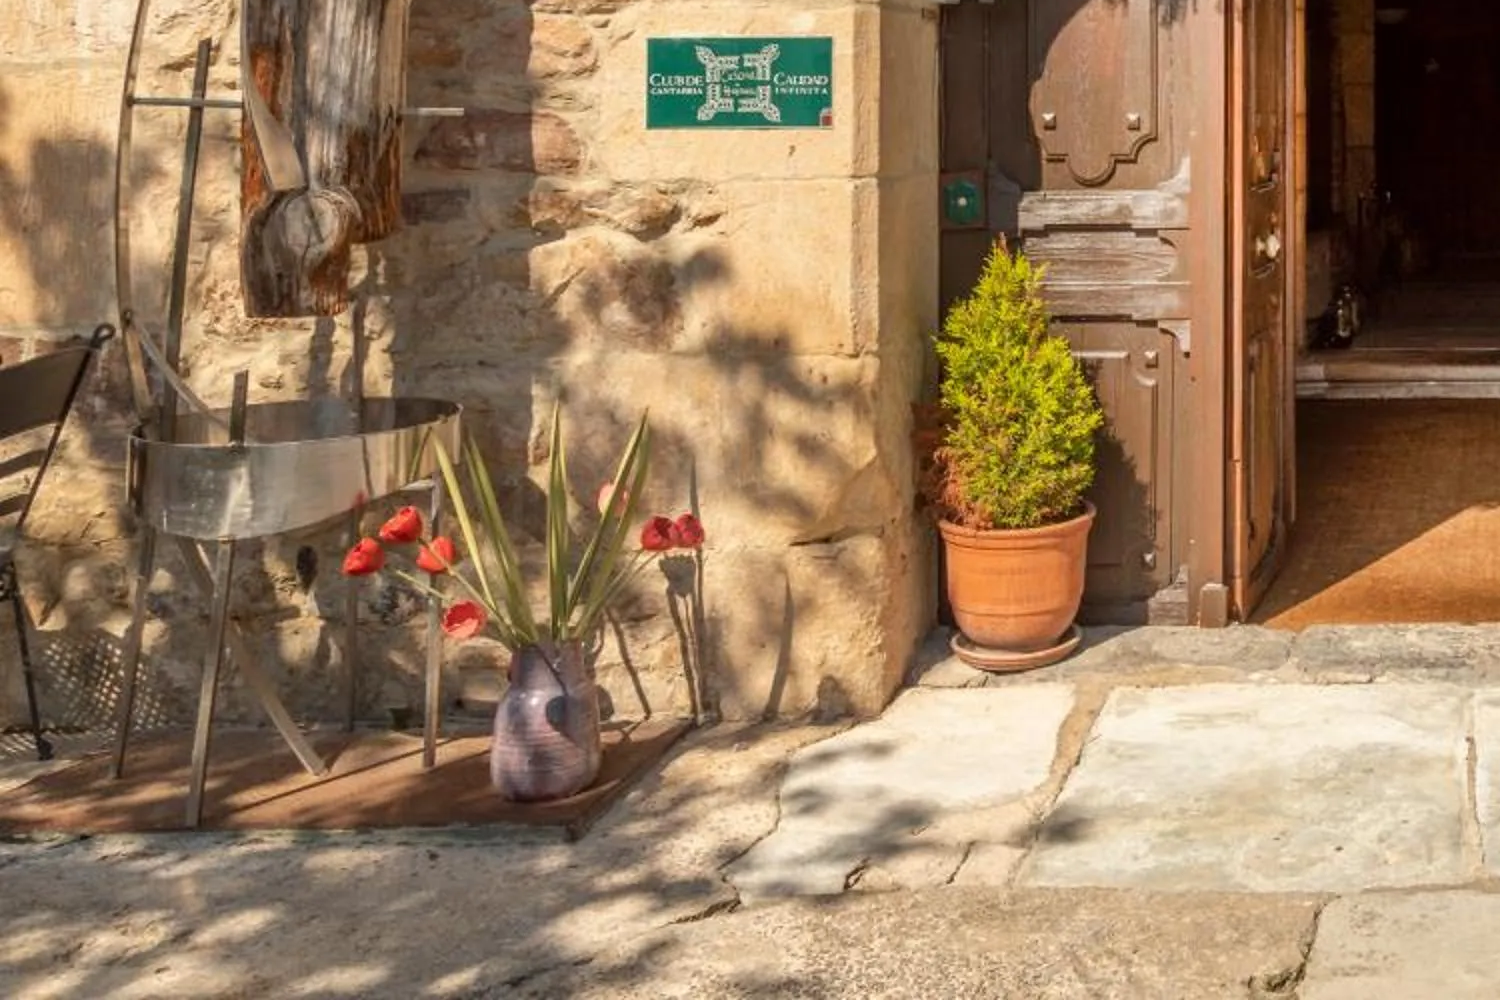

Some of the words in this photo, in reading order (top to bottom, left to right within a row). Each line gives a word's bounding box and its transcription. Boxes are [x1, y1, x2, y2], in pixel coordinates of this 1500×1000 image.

[773, 71, 829, 87] CALIDAD
[650, 87, 703, 95] CANTABRIA
[775, 87, 829, 95] INFINITA
